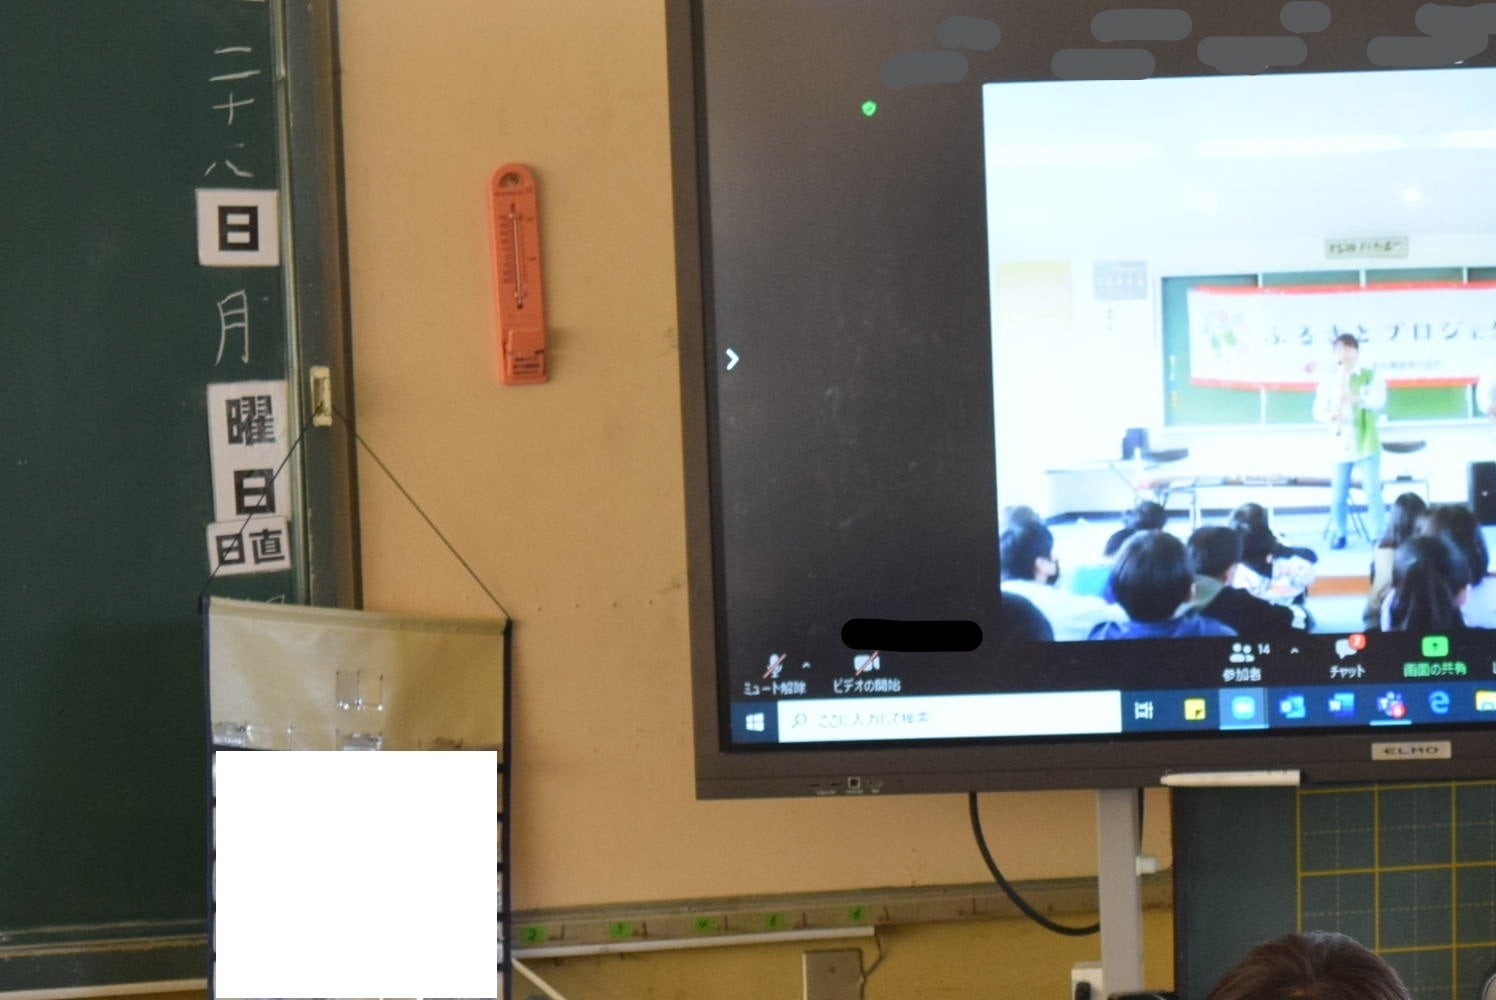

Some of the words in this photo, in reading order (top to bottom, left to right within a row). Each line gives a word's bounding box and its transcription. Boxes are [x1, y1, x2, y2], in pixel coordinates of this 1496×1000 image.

[217, 205, 259, 252] 日
[215, 290, 249, 366] 月
[226, 395, 275, 515] 曜日
[216, 529, 285, 565] 日直
[1222, 667, 1262, 682] 参加者
[1329, 664, 1366, 679] チャット
[1403, 661, 1468, 678] 画面の共有
[743, 680, 807, 696] ミュート解除
[833, 677, 902, 694] ビデオの開始
